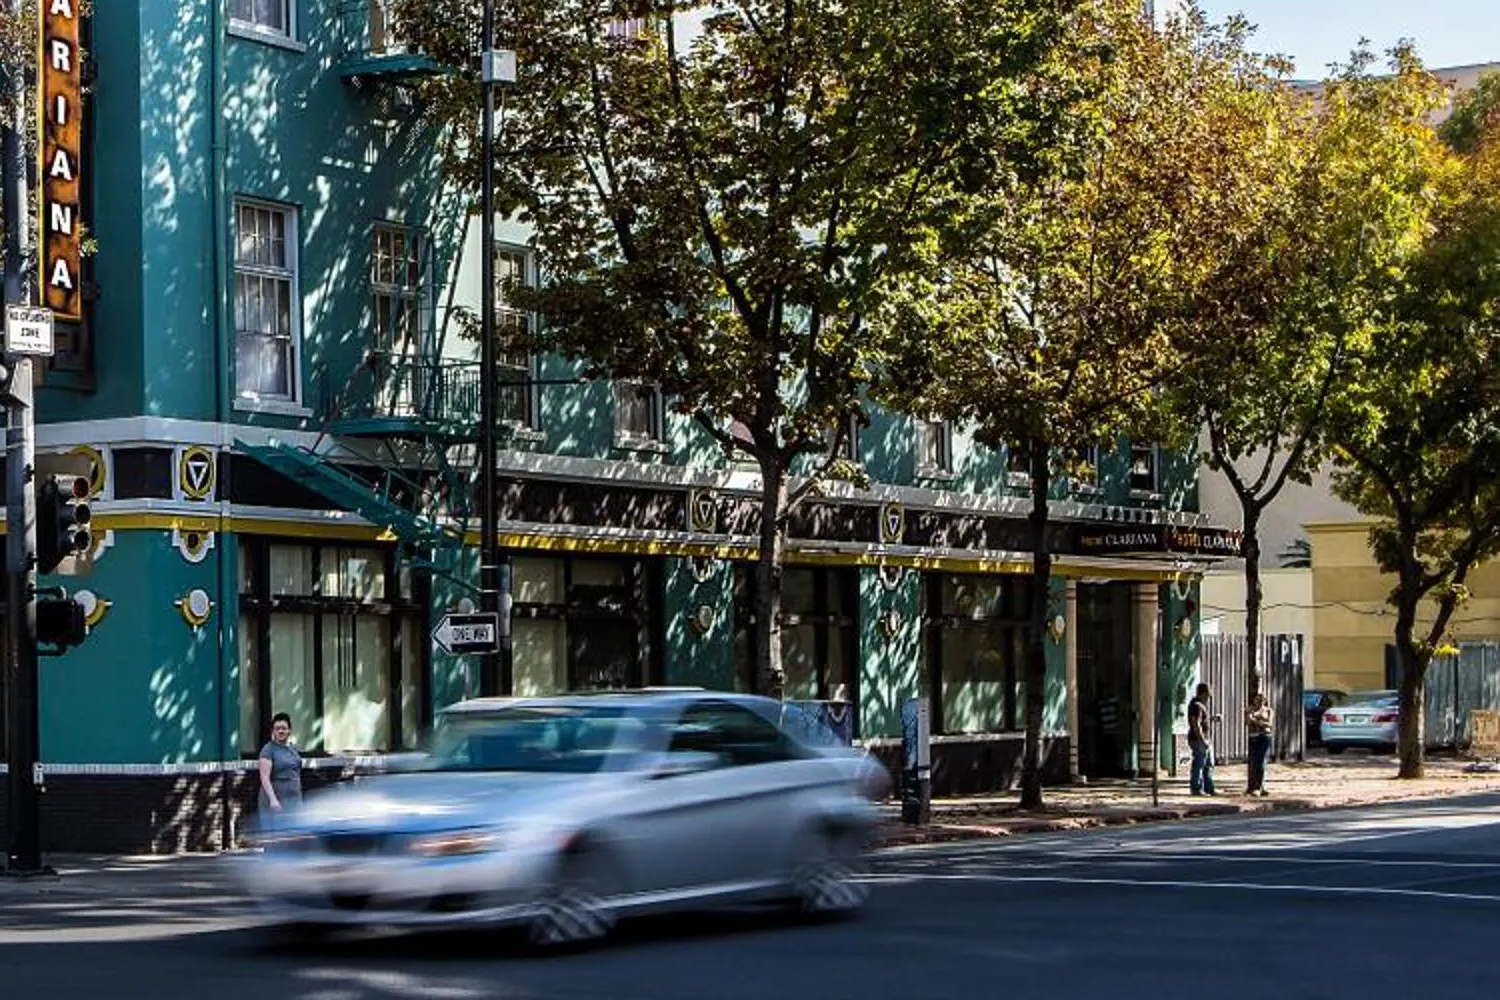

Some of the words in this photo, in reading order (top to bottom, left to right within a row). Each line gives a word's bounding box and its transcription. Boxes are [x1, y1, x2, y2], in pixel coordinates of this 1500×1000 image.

[21, 327, 40, 338] ZONE
[452, 627, 471, 641] ONE
[473, 626, 490, 641] WAY
